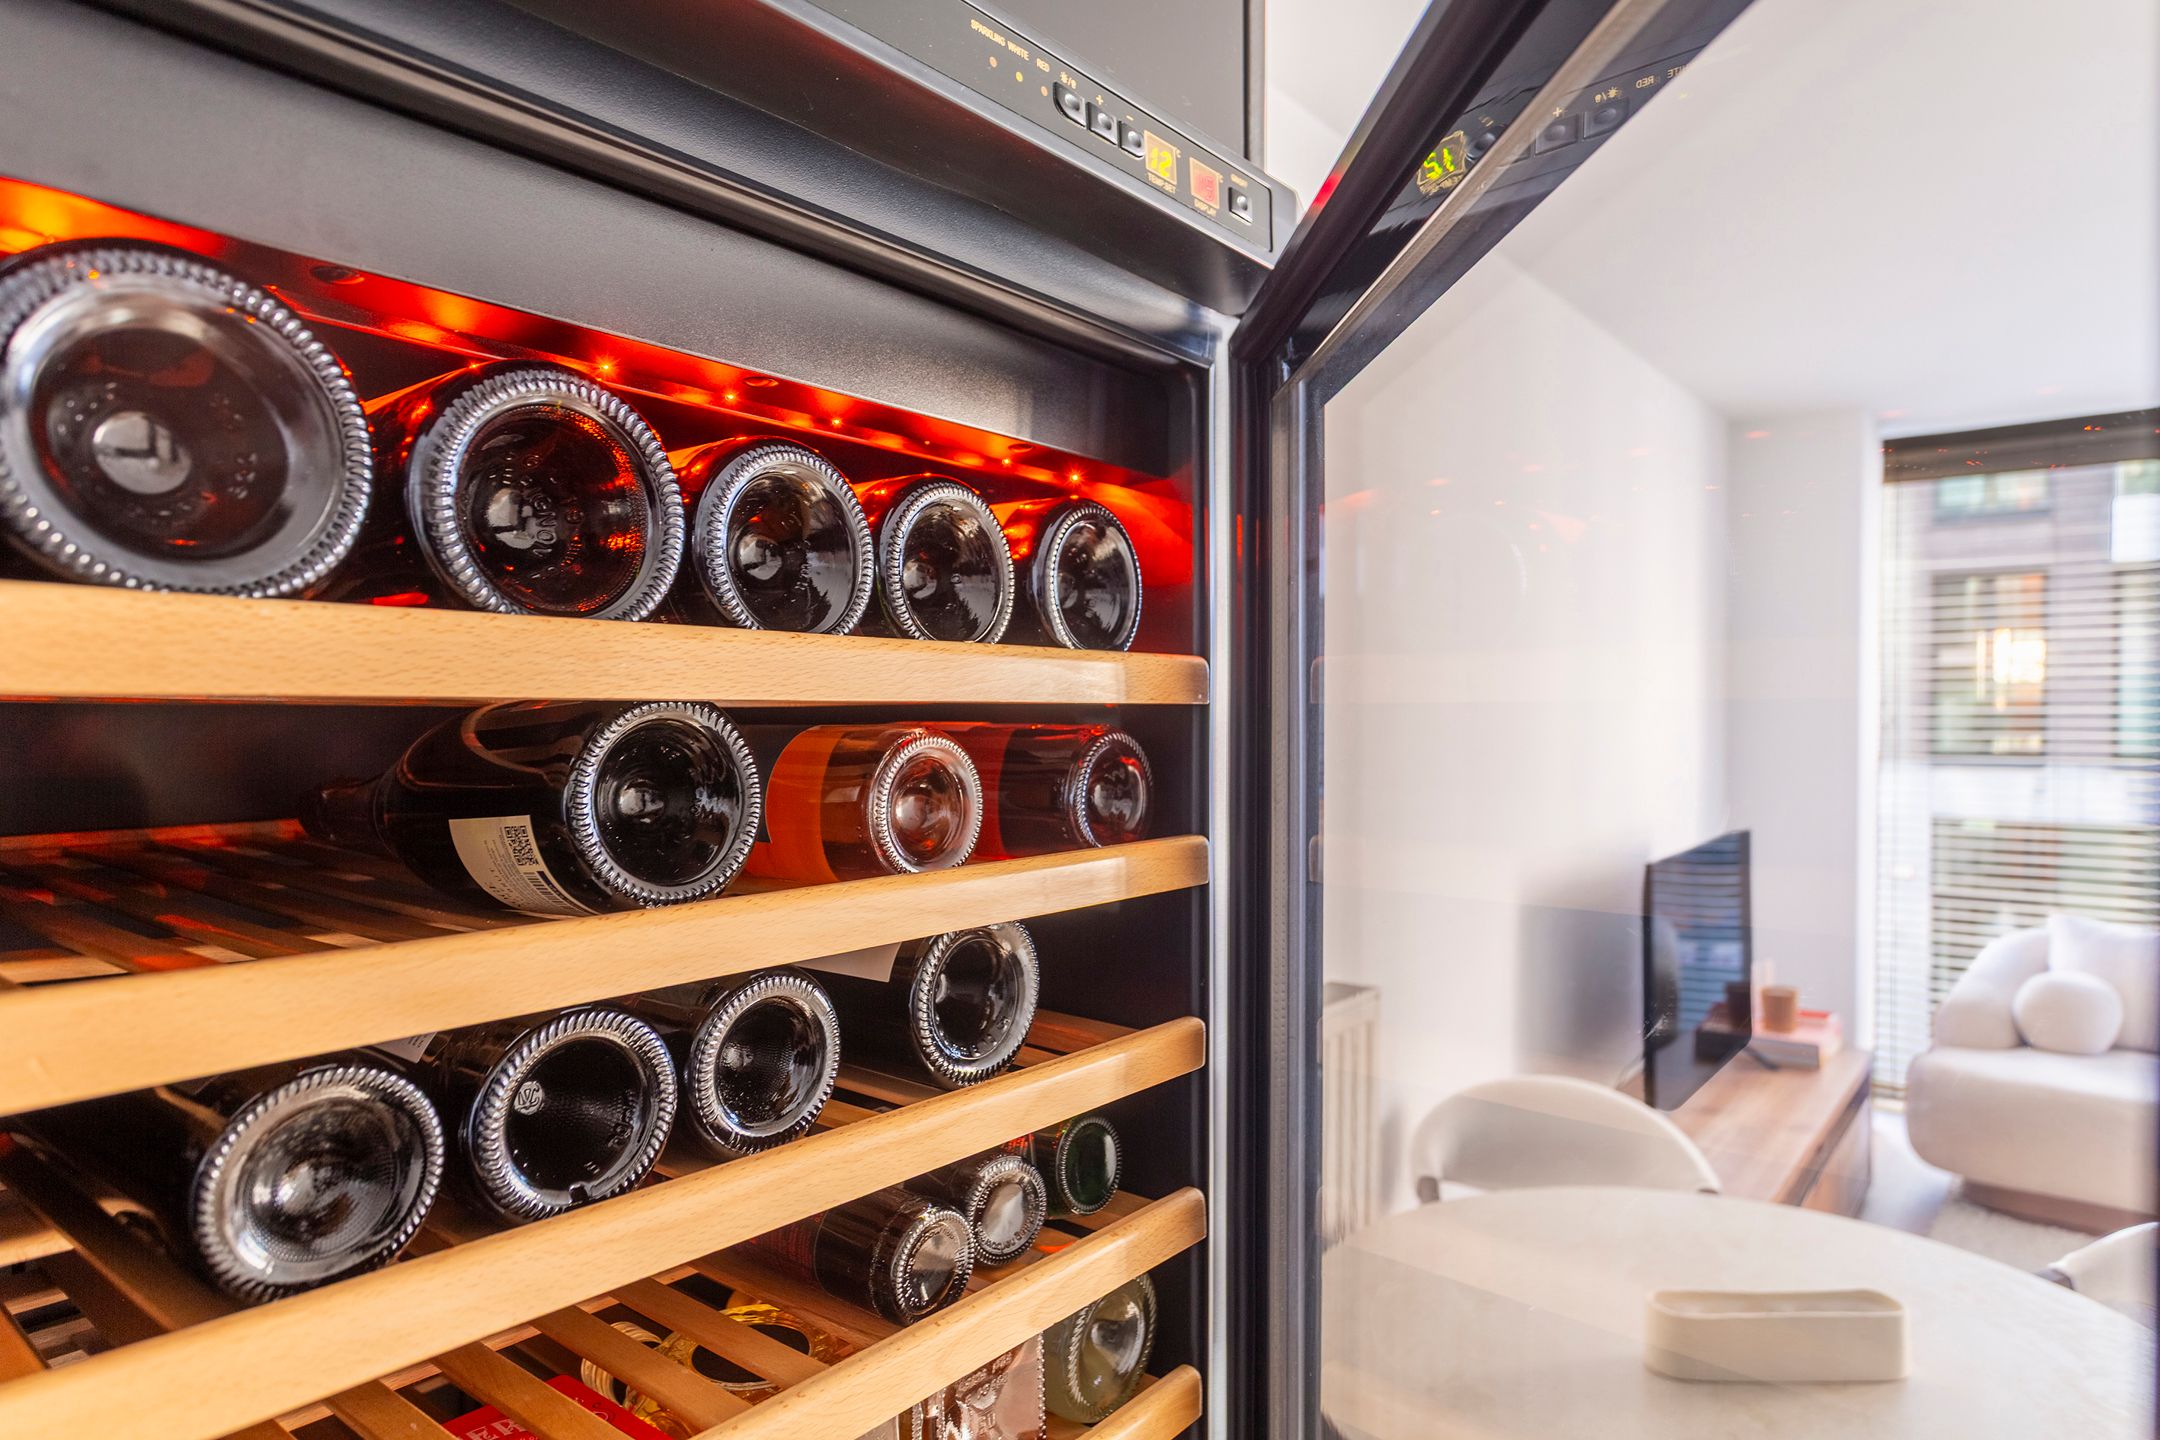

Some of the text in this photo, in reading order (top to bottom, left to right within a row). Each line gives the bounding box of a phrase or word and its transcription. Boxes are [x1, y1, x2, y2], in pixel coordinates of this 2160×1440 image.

[970, 19, 1050, 72] SPARKLING WHITE RED
[1151, 147, 1173, 177] 12
